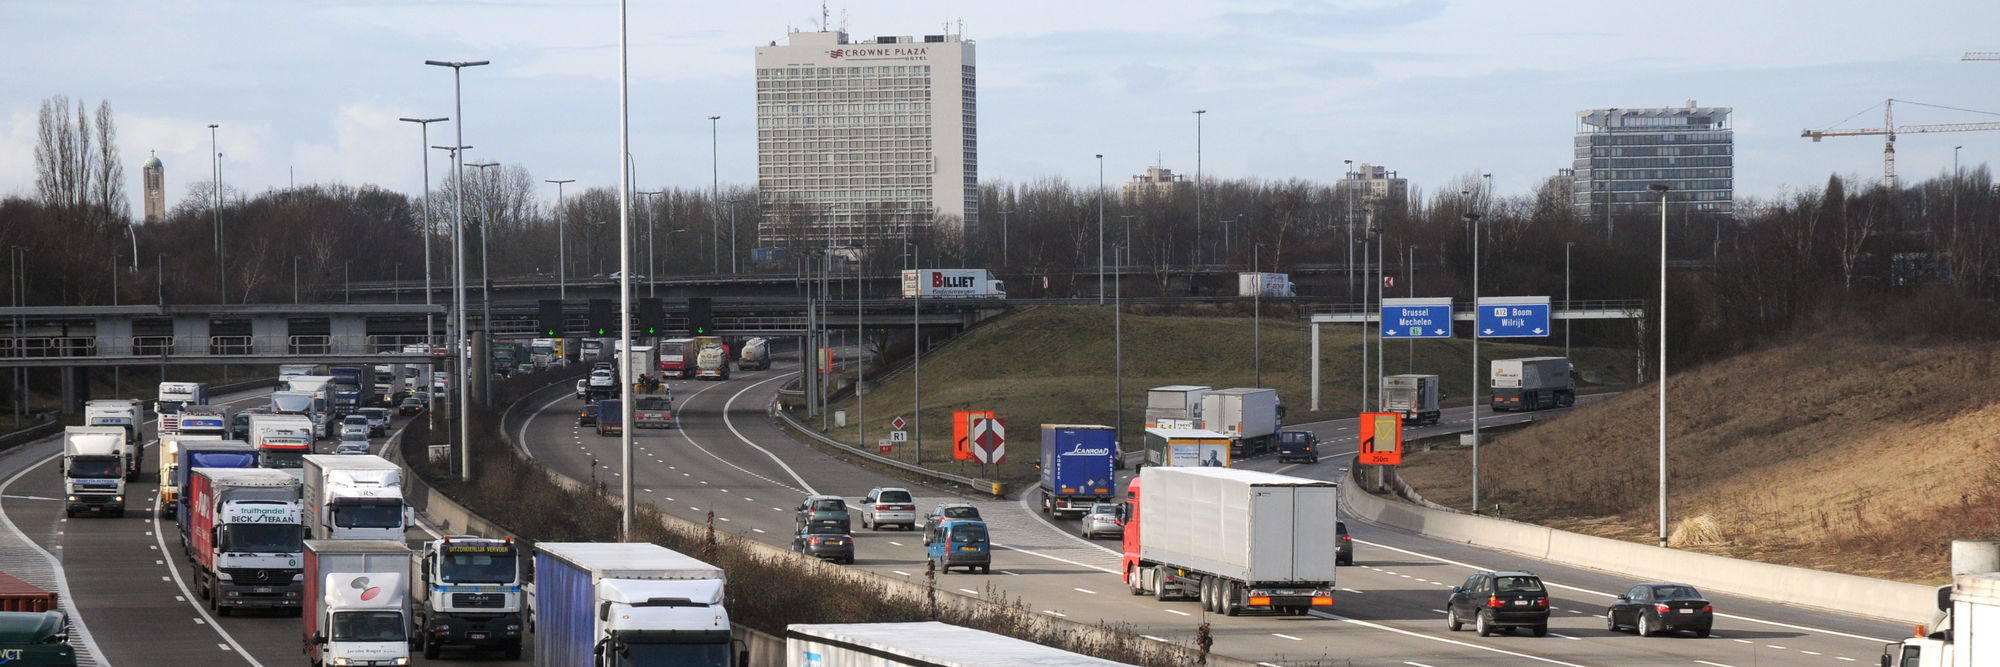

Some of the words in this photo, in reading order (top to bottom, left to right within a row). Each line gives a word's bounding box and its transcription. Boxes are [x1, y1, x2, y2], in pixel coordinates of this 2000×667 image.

[932, 271, 975, 287] BILLIET
[1402, 308, 1429, 317] Brussel
[1512, 308, 1532, 316] Boom
[1399, 318, 1432, 326] Mechelen
[1501, 318, 1525, 328] Wilrijk
[893, 432, 904, 441] R1
[1062, 443, 1109, 456] SCANROAD
[1372, 455, 1389, 463] 250m
[231, 515, 253, 523] BECK
[255, 514, 295, 523] STEFAAN
